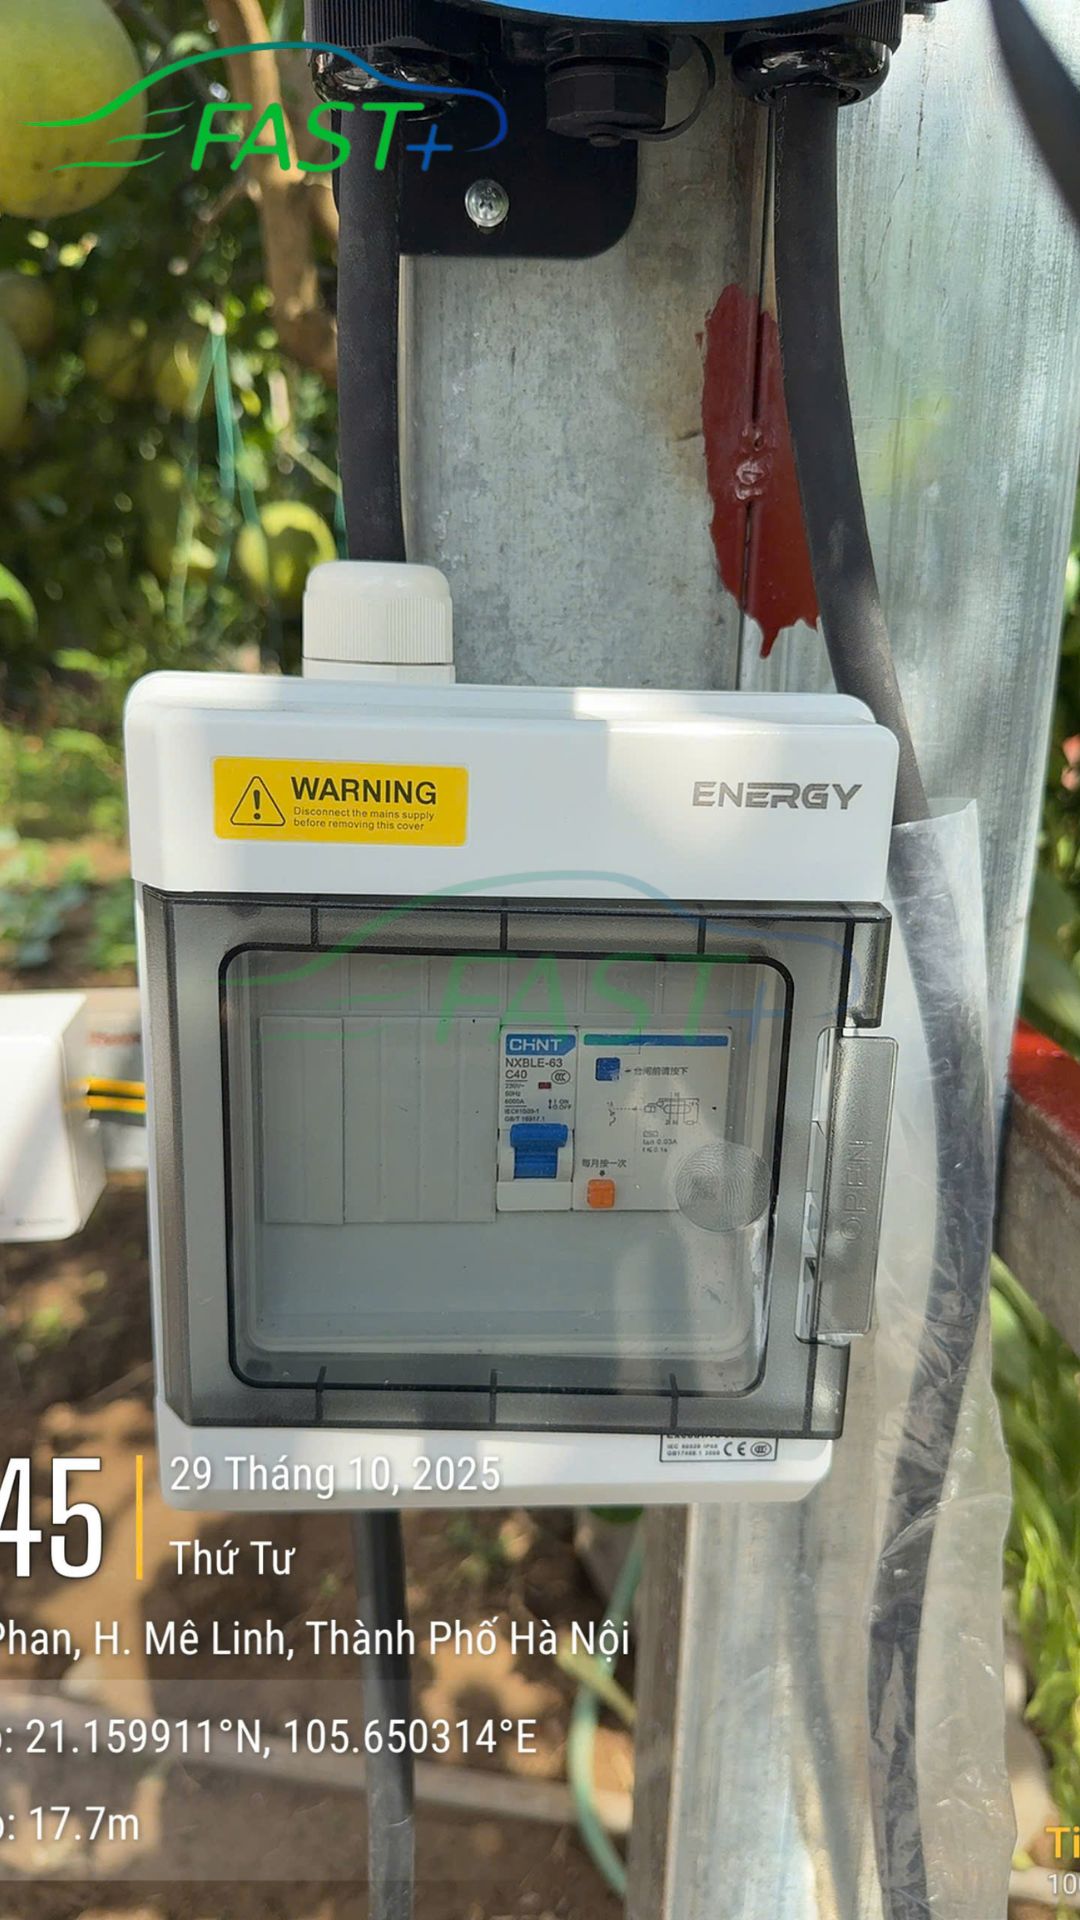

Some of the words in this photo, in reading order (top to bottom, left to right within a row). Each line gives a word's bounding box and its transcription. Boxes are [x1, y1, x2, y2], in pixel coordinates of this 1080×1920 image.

[291, 776, 436, 805] WARNING
[692, 781, 863, 810] ENERGY
[293, 806, 350, 817] Disconnect
[352, 808, 367, 818] the
[370, 810, 400, 819] mains
[402, 811, 435, 822] supply
[293, 818, 326, 828] before
[328, 819, 375, 831] removing
[376, 820, 395, 830] this
[397, 821, 424, 831] cover
[505, 1057, 563, 1068] NXBLE-63
[505, 1069, 528, 1080] C40
